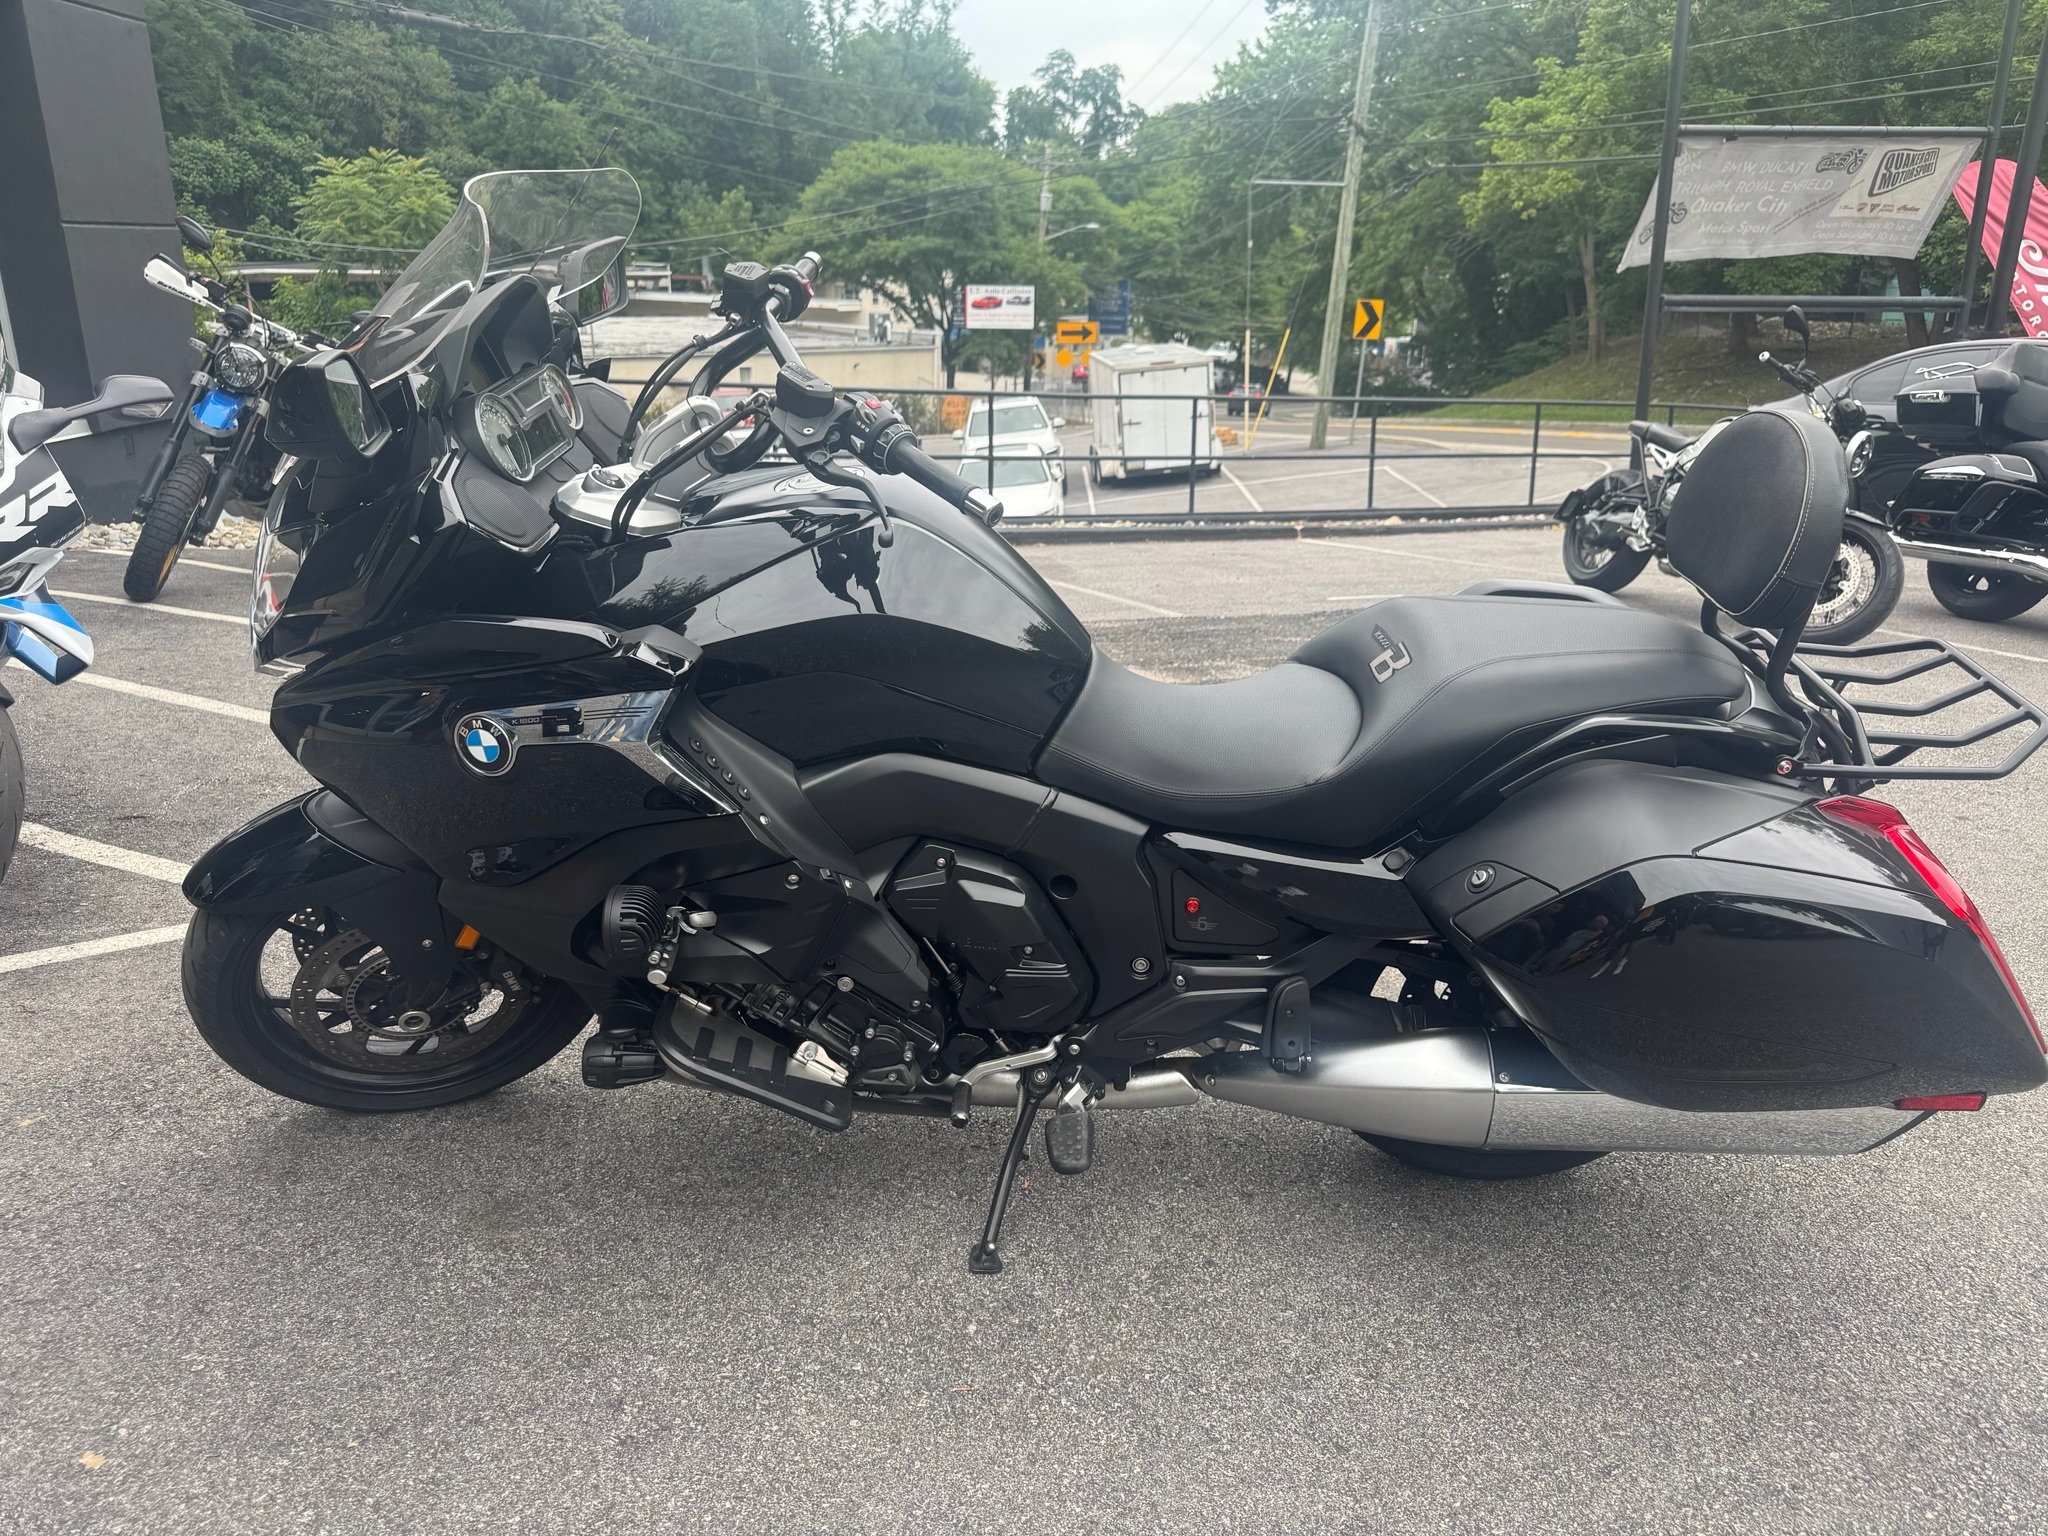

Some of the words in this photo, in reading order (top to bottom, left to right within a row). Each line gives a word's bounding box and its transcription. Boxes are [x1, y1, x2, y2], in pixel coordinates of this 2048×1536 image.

[1759, 161, 1808, 174] DUCATI
[1884, 152, 1925, 171] QUAKER
[1924, 150, 1938, 163] CITY
[1878, 162, 1935, 190] MOTORSPORT
[1735, 180, 1776, 193] ROYAL
[1780, 178, 1834, 193] ENFIELD
[1690, 195, 1751, 214] Quaker
[1756, 195, 1792, 217] City
[1698, 221, 1738, 234] Motor
[1737, 221, 1772, 235] Sport
[1815, 219, 1838, 230] Open
[1841, 218, 1881, 231] Weekdays
[1883, 221, 1894, 230] 10
[1812, 229, 1835, 240] Open
[1837, 229, 1874, 241] Saturday
[1877, 231, 1888, 240] 10
[1002, 287, 1032, 295] Collision
[459, 719, 502, 738] BMW
[502, 970, 522, 991] BMW
